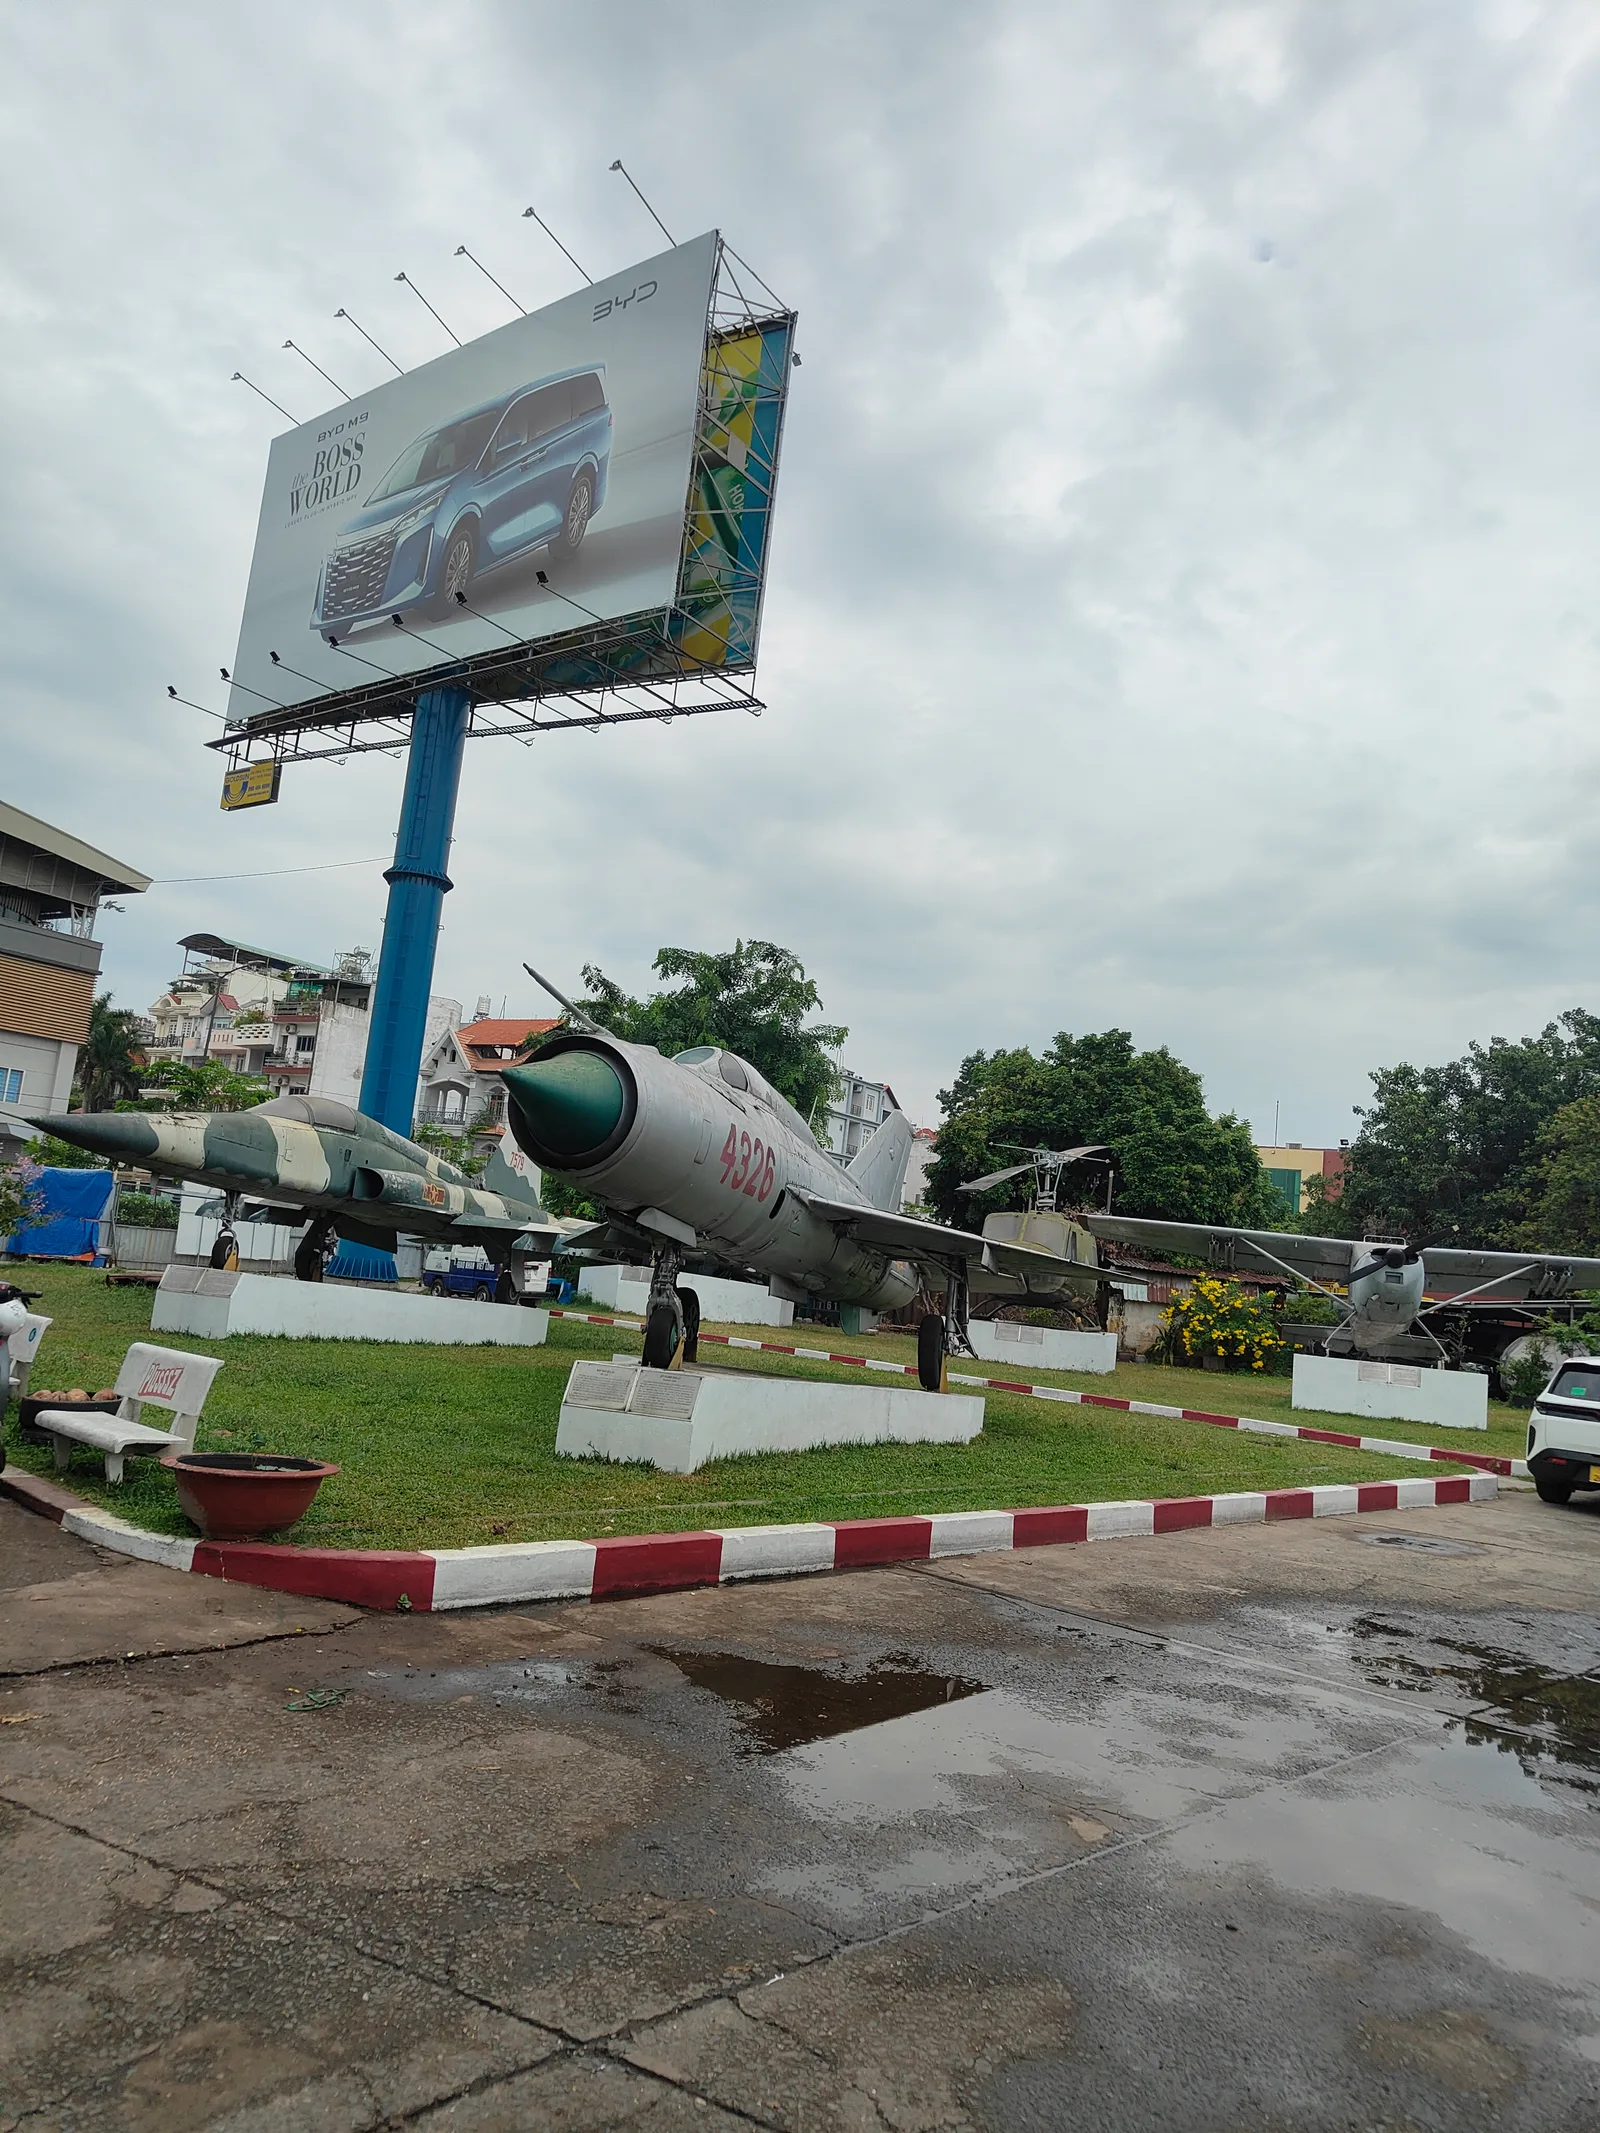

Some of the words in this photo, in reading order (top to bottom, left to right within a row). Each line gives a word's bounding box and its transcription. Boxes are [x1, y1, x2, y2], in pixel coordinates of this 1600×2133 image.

[593, 281, 658, 322] BYD
[317, 423, 345, 442] BYD
[348, 412, 369, 428] M9
[292, 472, 309, 489] the
[312, 431, 366, 480] BOSS
[290, 463, 361, 516] WORLD
[225, 774, 249, 783] GOLDSUN
[510, 1151, 525, 1171] 7579
[720, 1123, 776, 1202] 4326
